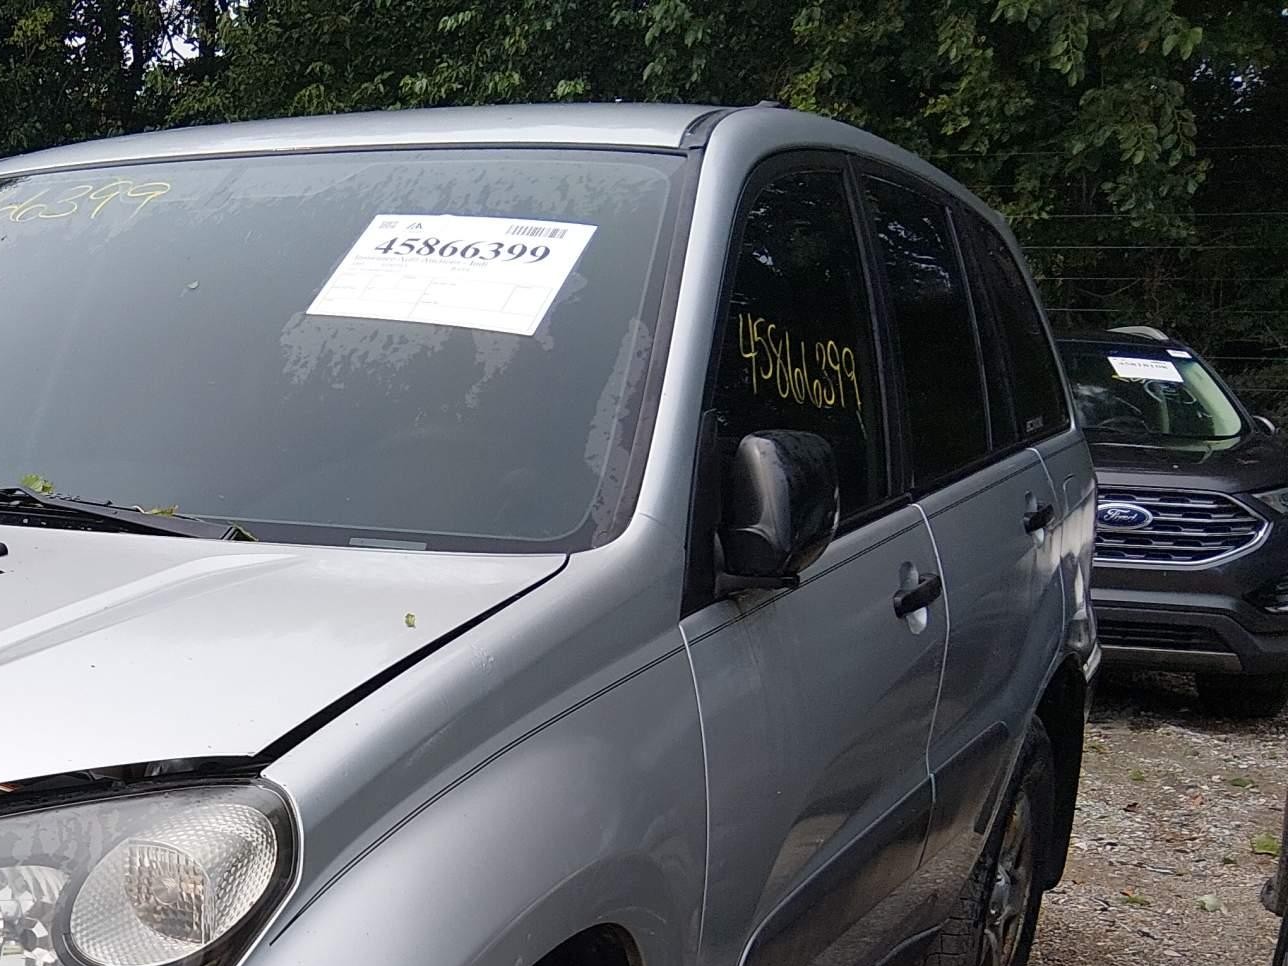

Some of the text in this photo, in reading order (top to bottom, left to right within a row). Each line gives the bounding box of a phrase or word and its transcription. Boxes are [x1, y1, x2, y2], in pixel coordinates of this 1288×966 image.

[374, 237, 551, 264] 45866399
[738, 312, 862, 409] 45866399
[1103, 508, 1138, 521] Ford
